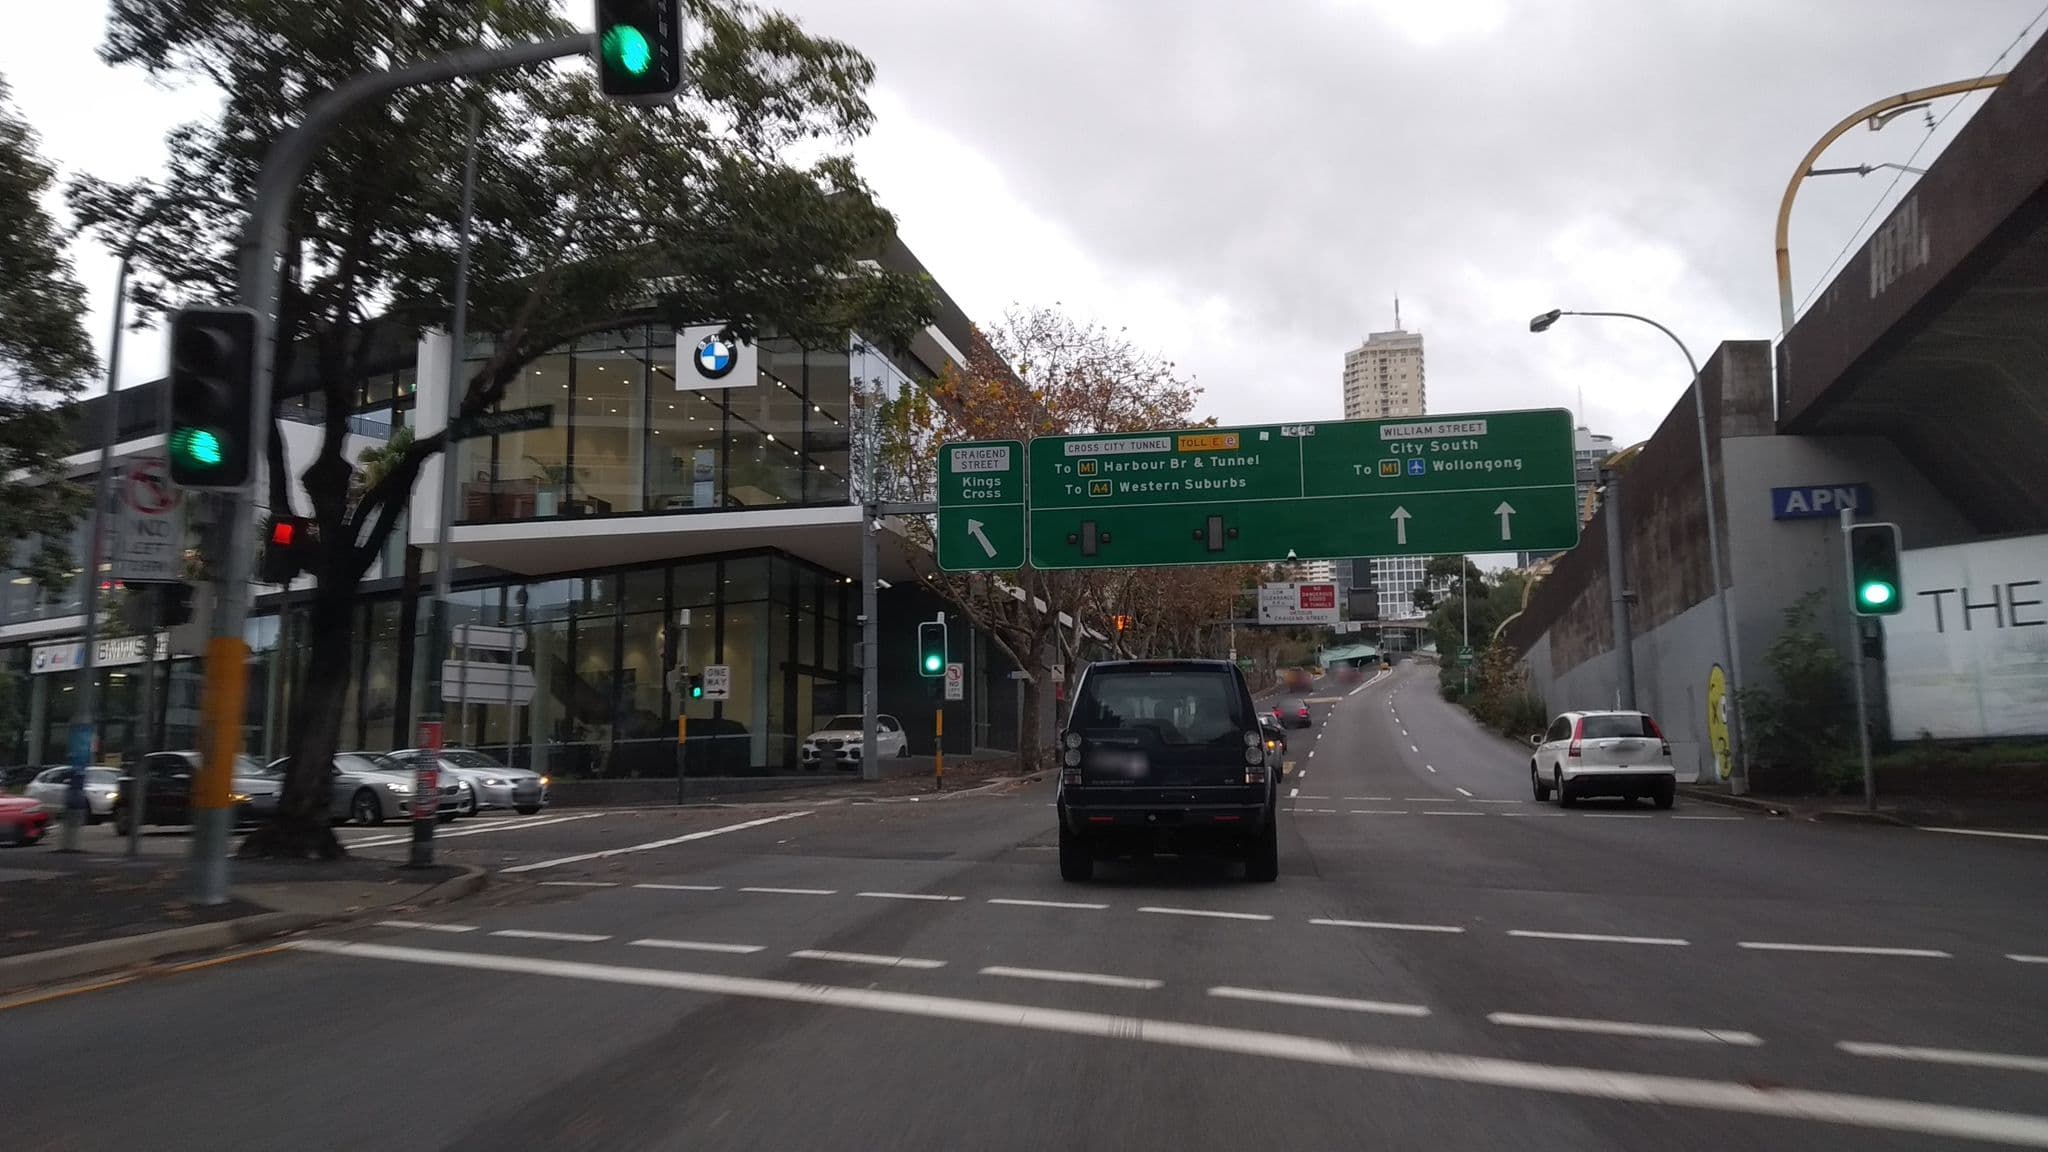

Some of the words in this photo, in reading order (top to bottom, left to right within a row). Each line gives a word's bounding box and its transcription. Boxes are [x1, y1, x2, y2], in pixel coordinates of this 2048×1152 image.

[1384, 425, 1433, 437] WILLIAM
[1438, 423, 1484, 434] STREET
[1068, 443, 1100, 453] CROSS
[1104, 441, 1125, 451] CITY
[1131, 440, 1168, 450] TUNNEL
[1181, 439, 1207, 448] TOLL
[1390, 442, 1424, 455] City
[1430, 439, 1479, 452] South
[954, 449, 1006, 460] CRAIGEND
[961, 460, 999, 470] STREET
[1055, 463, 1071, 474] To
[1081, 462, 1095, 473] M1
[1104, 460, 1165, 472] Harbour
[1170, 458, 1187, 469] Br
[1194, 457, 1204, 468] &
[1210, 454, 1259, 467] Tunnel
[1353, 464, 1372, 475] To
[1382, 462, 1398, 473] M1
[1432, 458, 1522, 472] Wollongong
[962, 476, 1002, 489] Kings
[1065, 484, 1082, 495] To
[1093, 483, 1109, 494] A4
[1119, 481, 1180, 493] Western
[1184, 478, 1247, 490] Suburbs
[962, 489, 1002, 499] Cross
[1786, 488, 1857, 512] APN
[1917, 580, 2047, 633] THE
[705, 668, 727, 677] ONE
